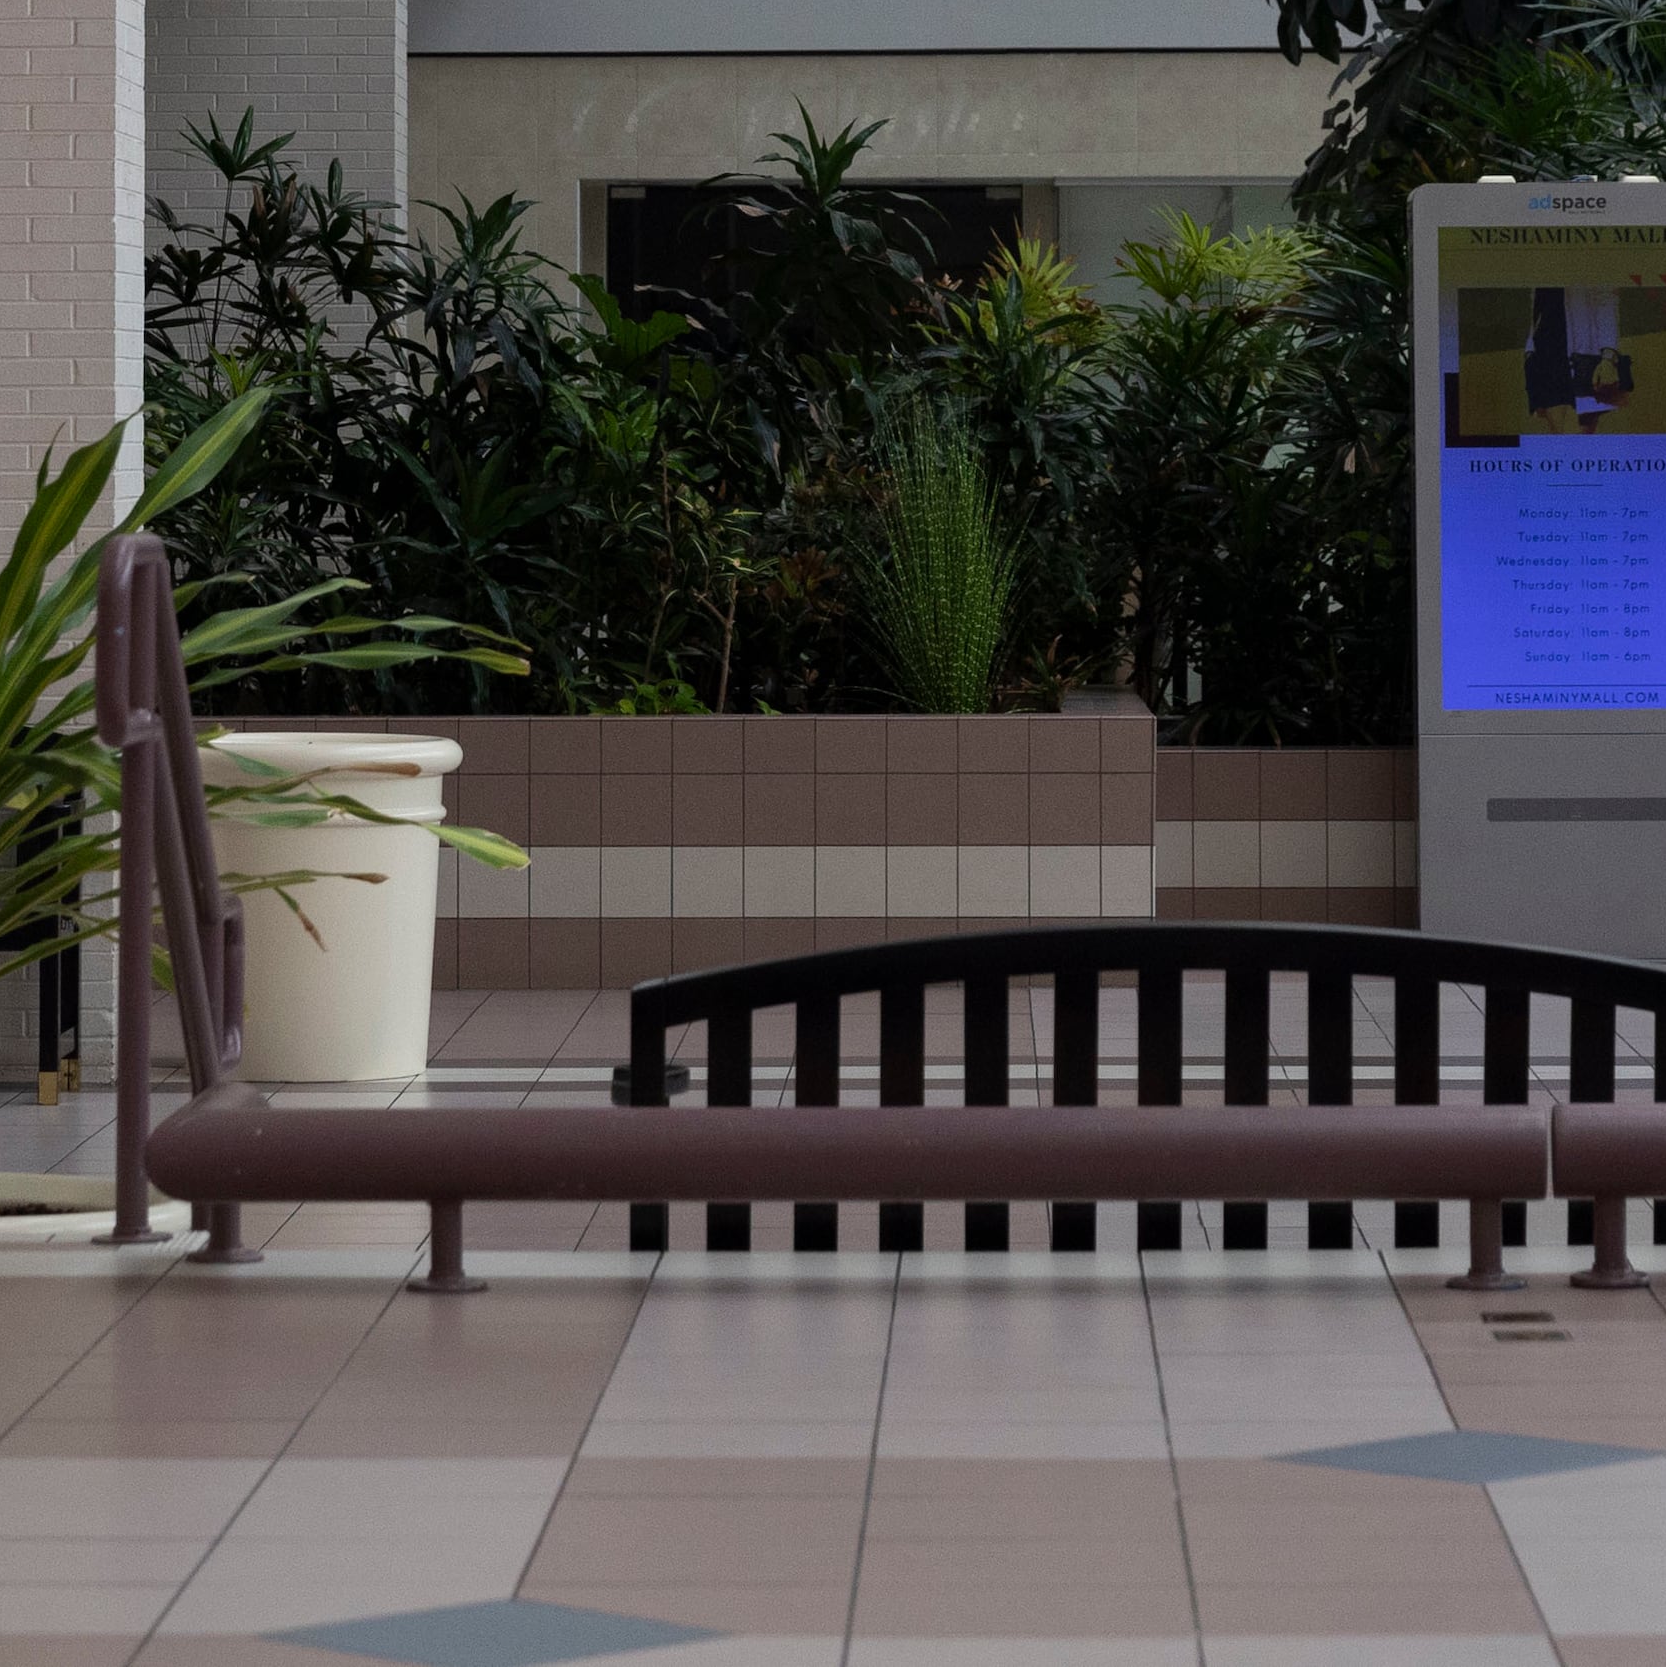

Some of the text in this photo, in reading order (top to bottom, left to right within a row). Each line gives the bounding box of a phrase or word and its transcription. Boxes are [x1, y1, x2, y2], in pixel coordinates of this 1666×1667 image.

[1528, 195, 1606, 212] adspace
[1469, 227, 1604, 244] NESHAMINY
[1469, 459, 1534, 473] HOURS
[1540, 459, 1564, 473] OF
[1495, 691, 1660, 704] NESHAMINYMALL.COM
